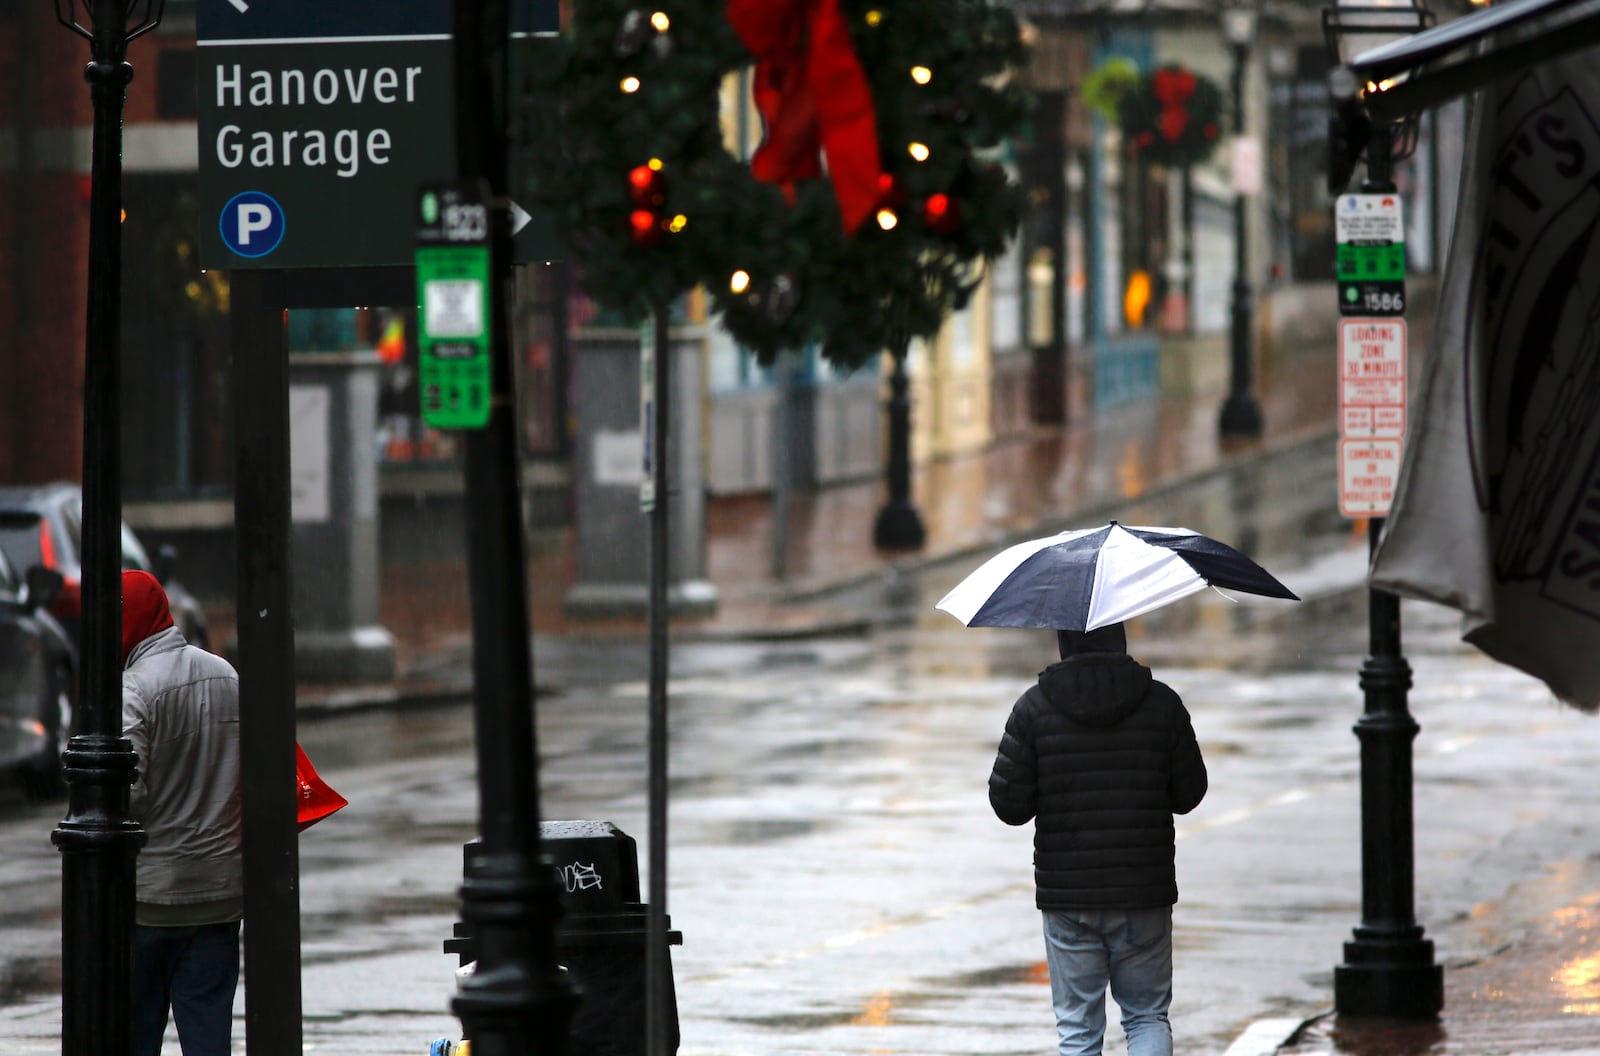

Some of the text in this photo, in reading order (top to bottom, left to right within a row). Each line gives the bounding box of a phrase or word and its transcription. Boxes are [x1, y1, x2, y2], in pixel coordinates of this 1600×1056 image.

[215, 62, 423, 108] Hanover
[215, 124, 393, 179] Garage
[236, 202, 272, 246] P
[1365, 294, 1404, 312] 1586
[1351, 327, 1395, 342] LOADING
[1360, 344, 1386, 358] ZONE
[1348, 361, 1399, 377] 30 MINUTE
